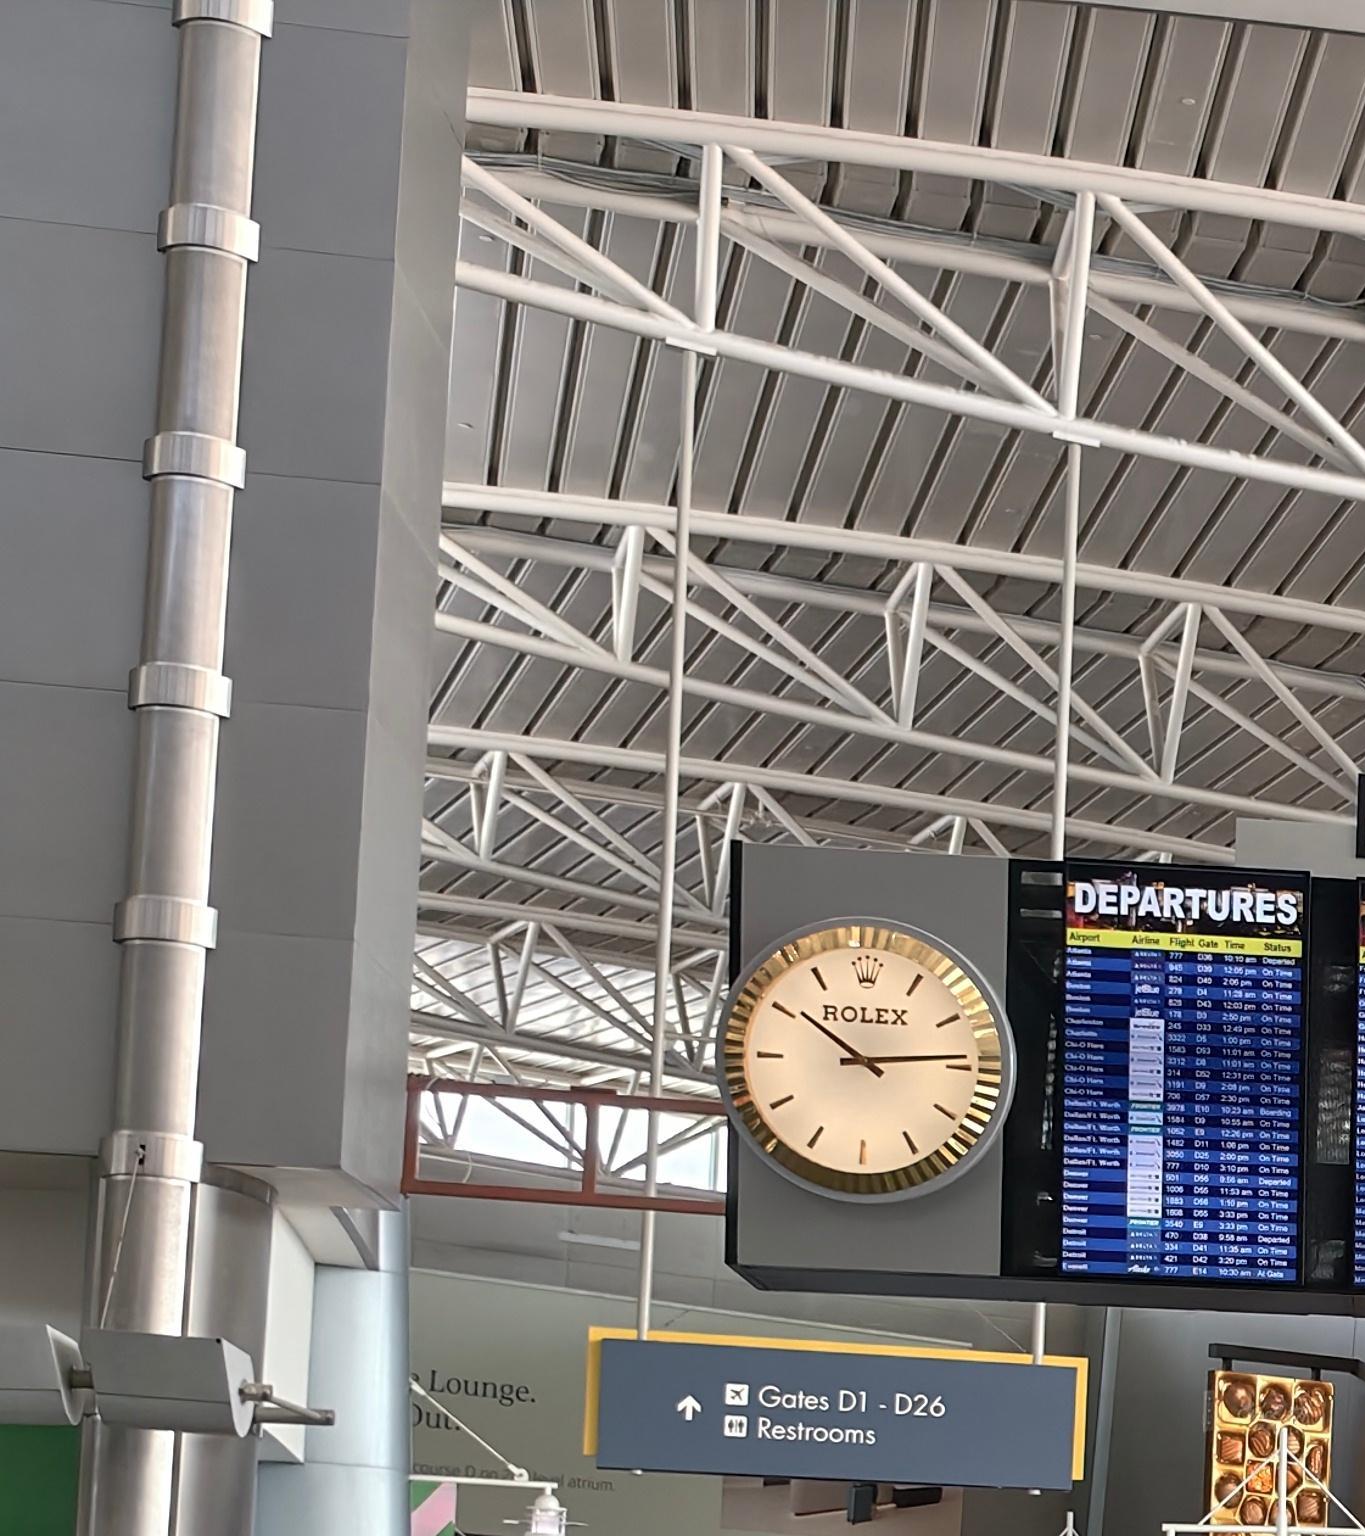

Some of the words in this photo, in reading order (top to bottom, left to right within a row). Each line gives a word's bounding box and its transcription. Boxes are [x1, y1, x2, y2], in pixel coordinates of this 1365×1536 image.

[1075, 882, 1297, 925] DEPARTURES
[1069, 932, 1100, 943] Airport
[1132, 934, 1160, 945] Airline
[1169, 936, 1194, 948] Flight
[1198, 938, 1218, 949] Gate
[1225, 940, 1245, 950] Time
[1264, 942, 1291, 953] Status
[822, 1005, 908, 1026] ROLEX
[1238, 1166, 1249, 1174] pm
[1259, 1166, 1270, 1174] On
[1272, 1167, 1289, 1175] Time
[429, 1370, 536, 1407] Lounge.
[758, 1385, 830, 1411] Gates
[838, 1390, 867, 1412] D1
[894, 1393, 946, 1417] D26
[758, 1417, 876, 1445] Restrooms
